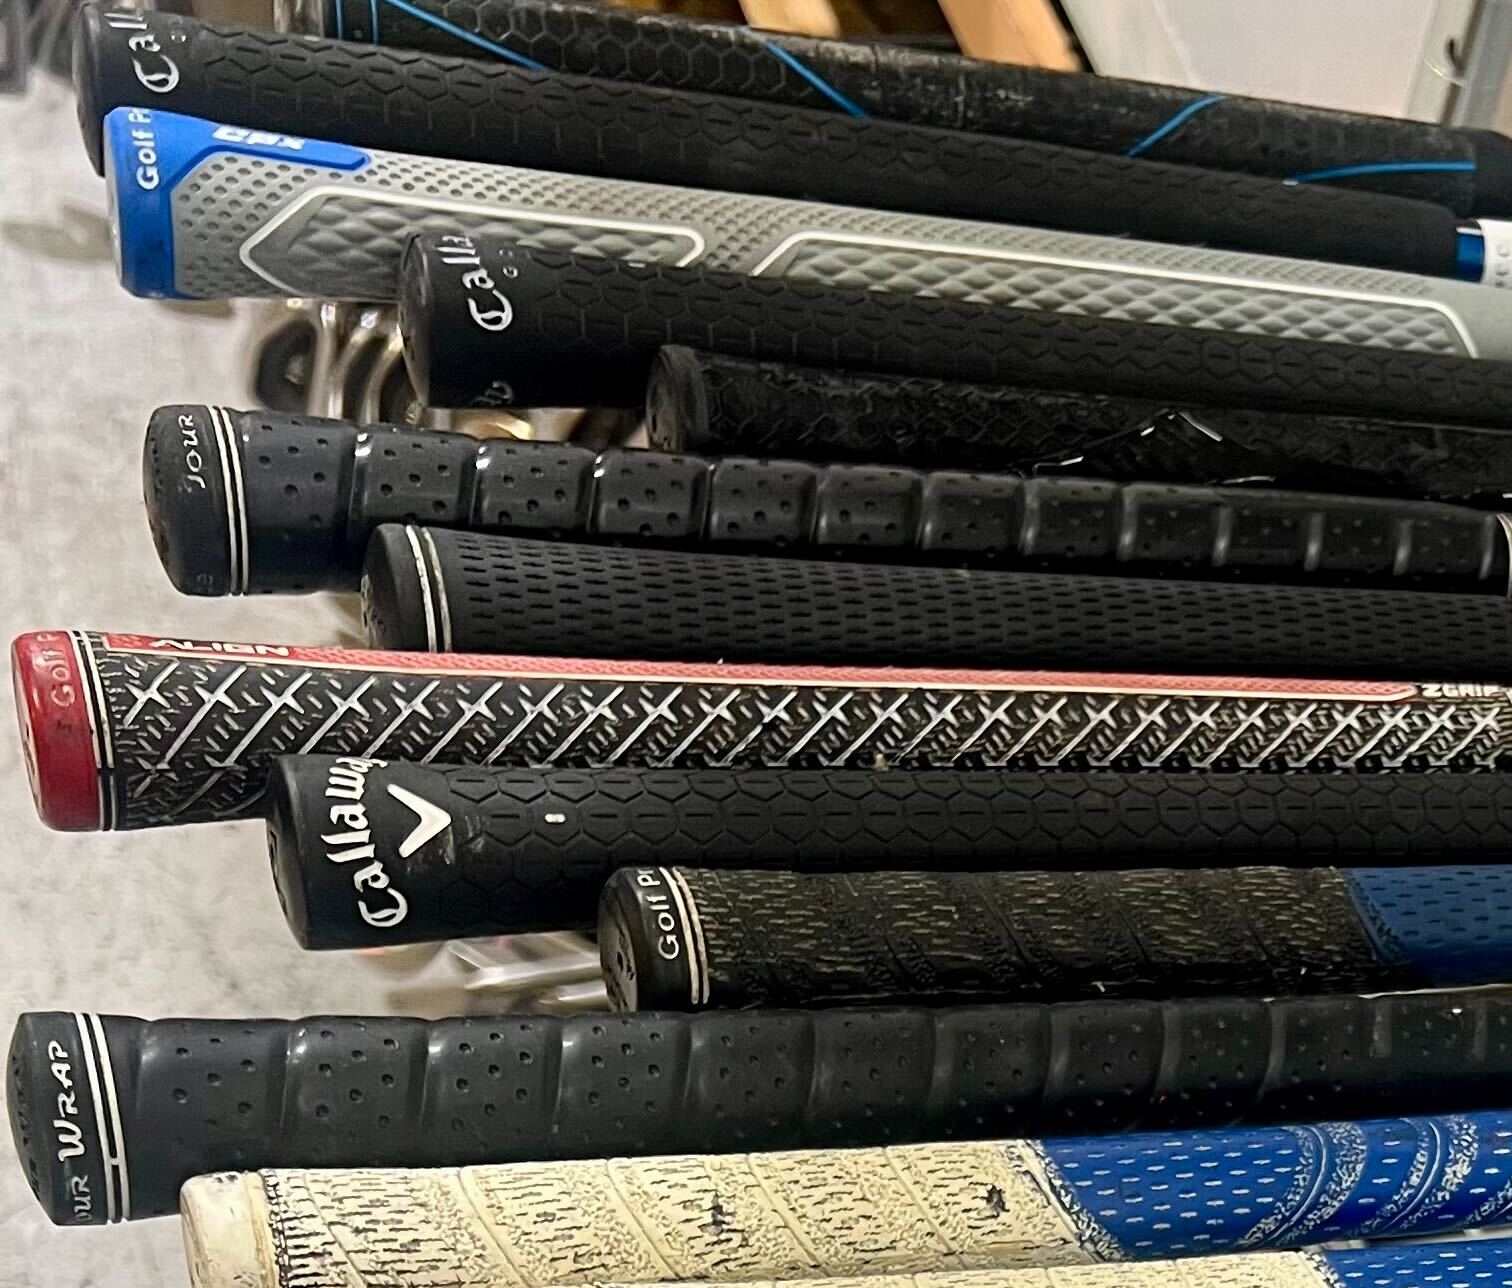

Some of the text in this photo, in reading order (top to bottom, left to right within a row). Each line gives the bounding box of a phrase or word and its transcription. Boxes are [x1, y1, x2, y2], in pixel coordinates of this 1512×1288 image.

[130, 126, 160, 190] Golf
[35, 648, 76, 706] Golf
[654, 891, 680, 960] Golf
[48, 1040, 87, 1163] WRAP
